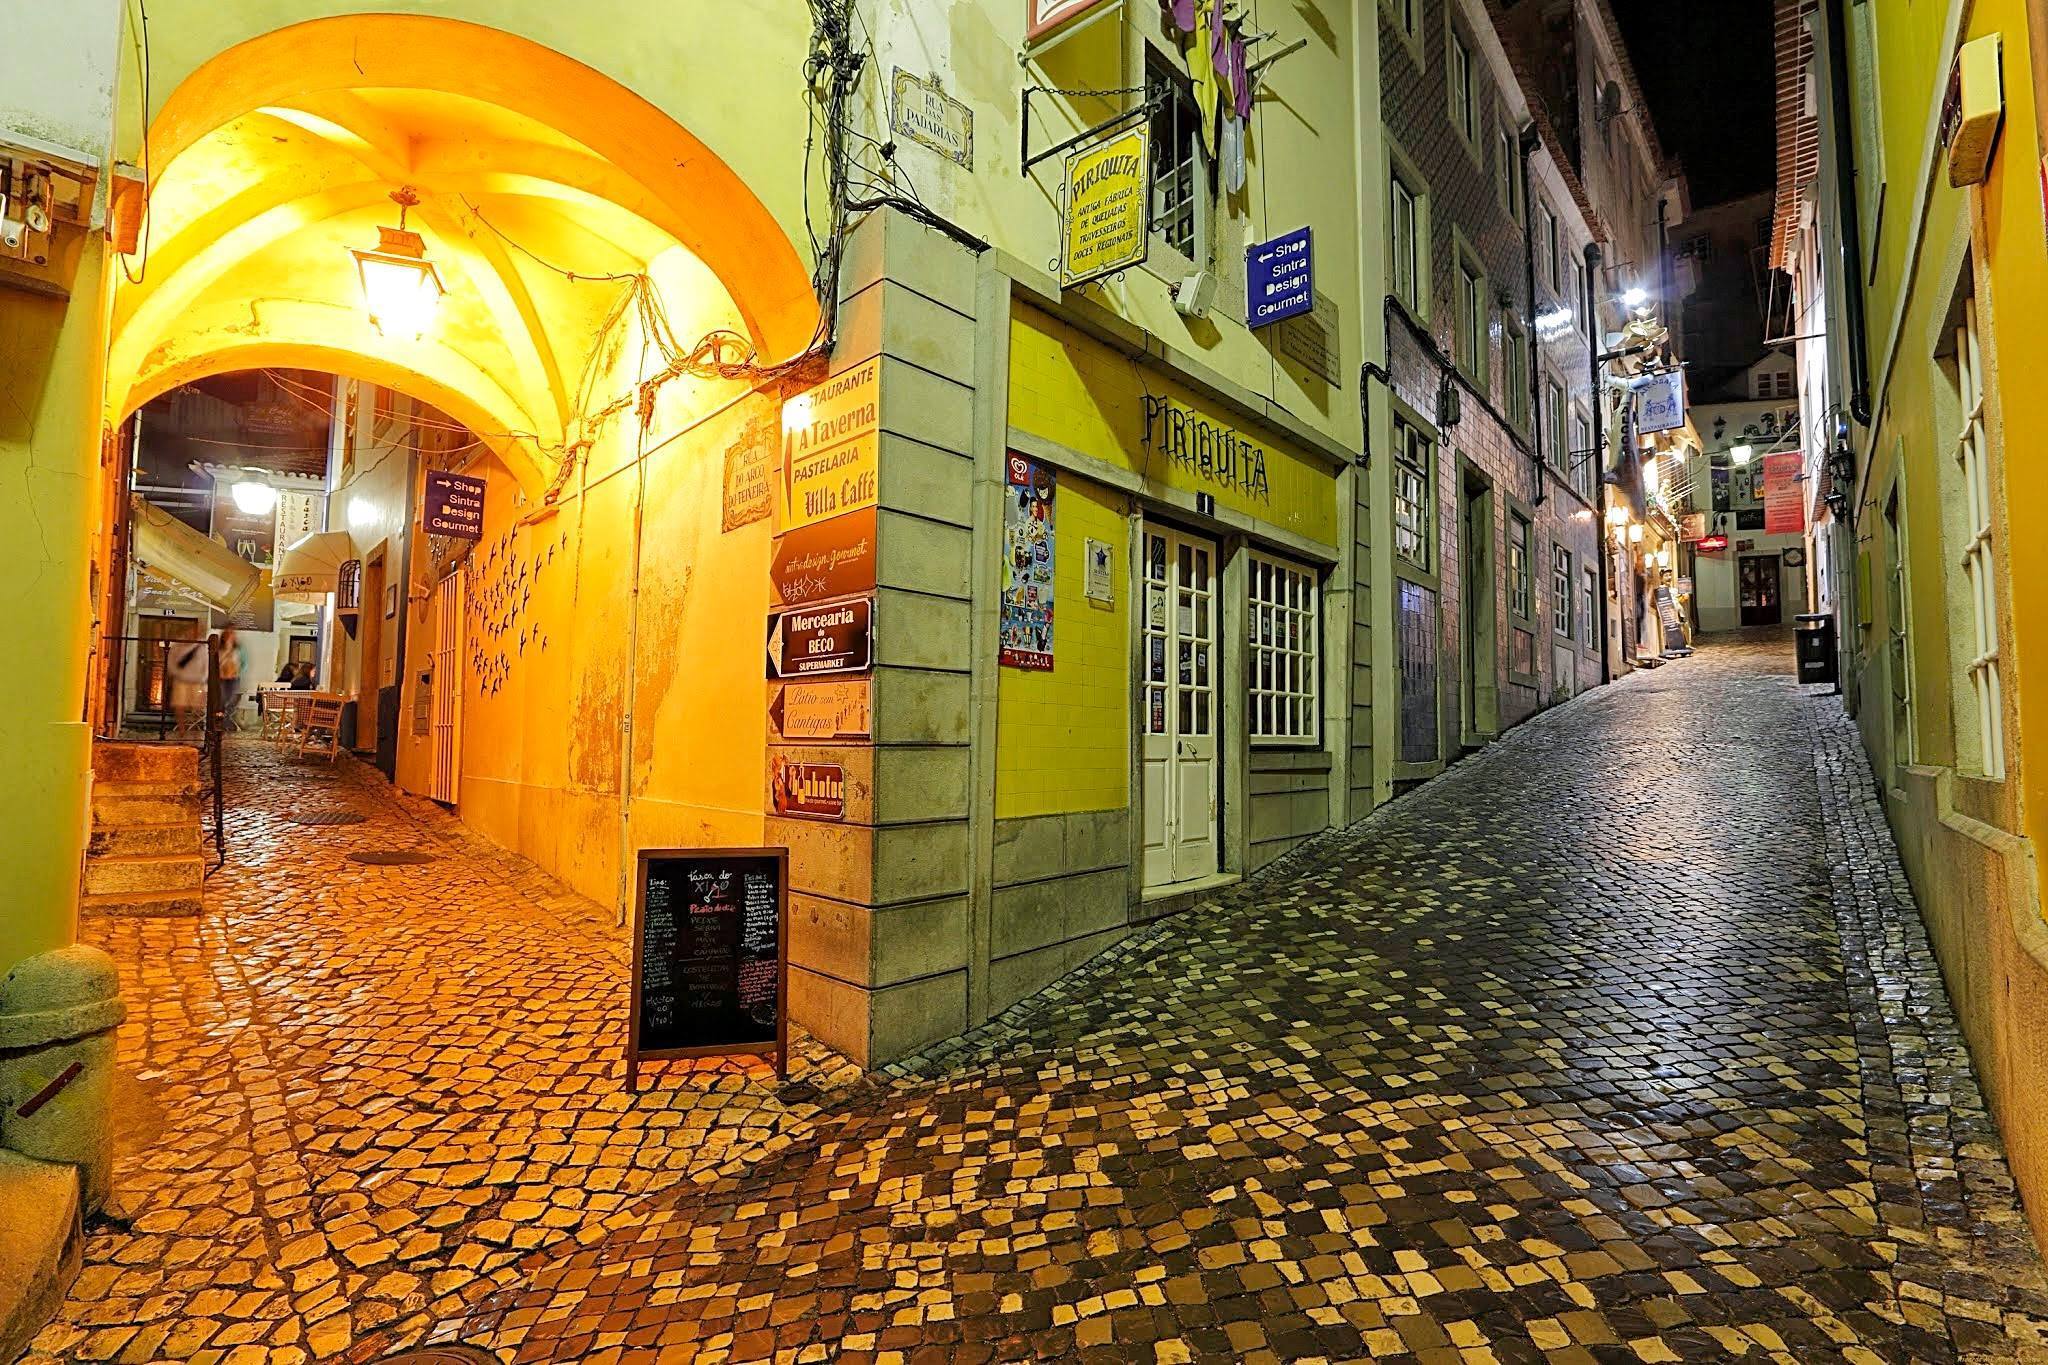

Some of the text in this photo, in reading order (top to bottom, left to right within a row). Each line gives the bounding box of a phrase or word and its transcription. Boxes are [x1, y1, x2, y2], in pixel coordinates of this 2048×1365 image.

[925, 93, 944, 114] RUA
[925, 106, 942, 121] DAS
[906, 107, 959, 147] PADARIAS
[1073, 155, 1140, 203] PIRIQUITA
[1077, 186, 1133, 217] ANTIGA FÁBRICA
[1080, 202, 1128, 229] DE QUEIJADAS
[1079, 219, 1127, 245] TRAVESSEIROS
[1073, 229, 1134, 262] DOCES REGIONAIS
[1275, 239, 1307, 258] Shop
[1272, 257, 1307, 278] Sintra
[1266, 273, 1308, 297] Design
[1257, 290, 1308, 317] Gourmet
[808, 365, 874, 410] STAURANTE
[799, 402, 876, 451] A Taverna
[1142, 394, 1268, 494] PIRIQUITA
[735, 464, 765, 488] DO ARCO
[793, 446, 859, 484] PASTELARIA
[453, 480, 482, 496] Shop
[442, 504, 480, 521] Design
[449, 494, 480, 508] Sintra
[804, 485, 837, 518] Villa
[432, 517, 479, 534] Gourmet
[791, 607, 854, 633] Mercearia
[808, 637, 834, 654] BECO
[798, 658, 845, 672] SUPERMARKET
[786, 711, 834, 736] Cantigas
